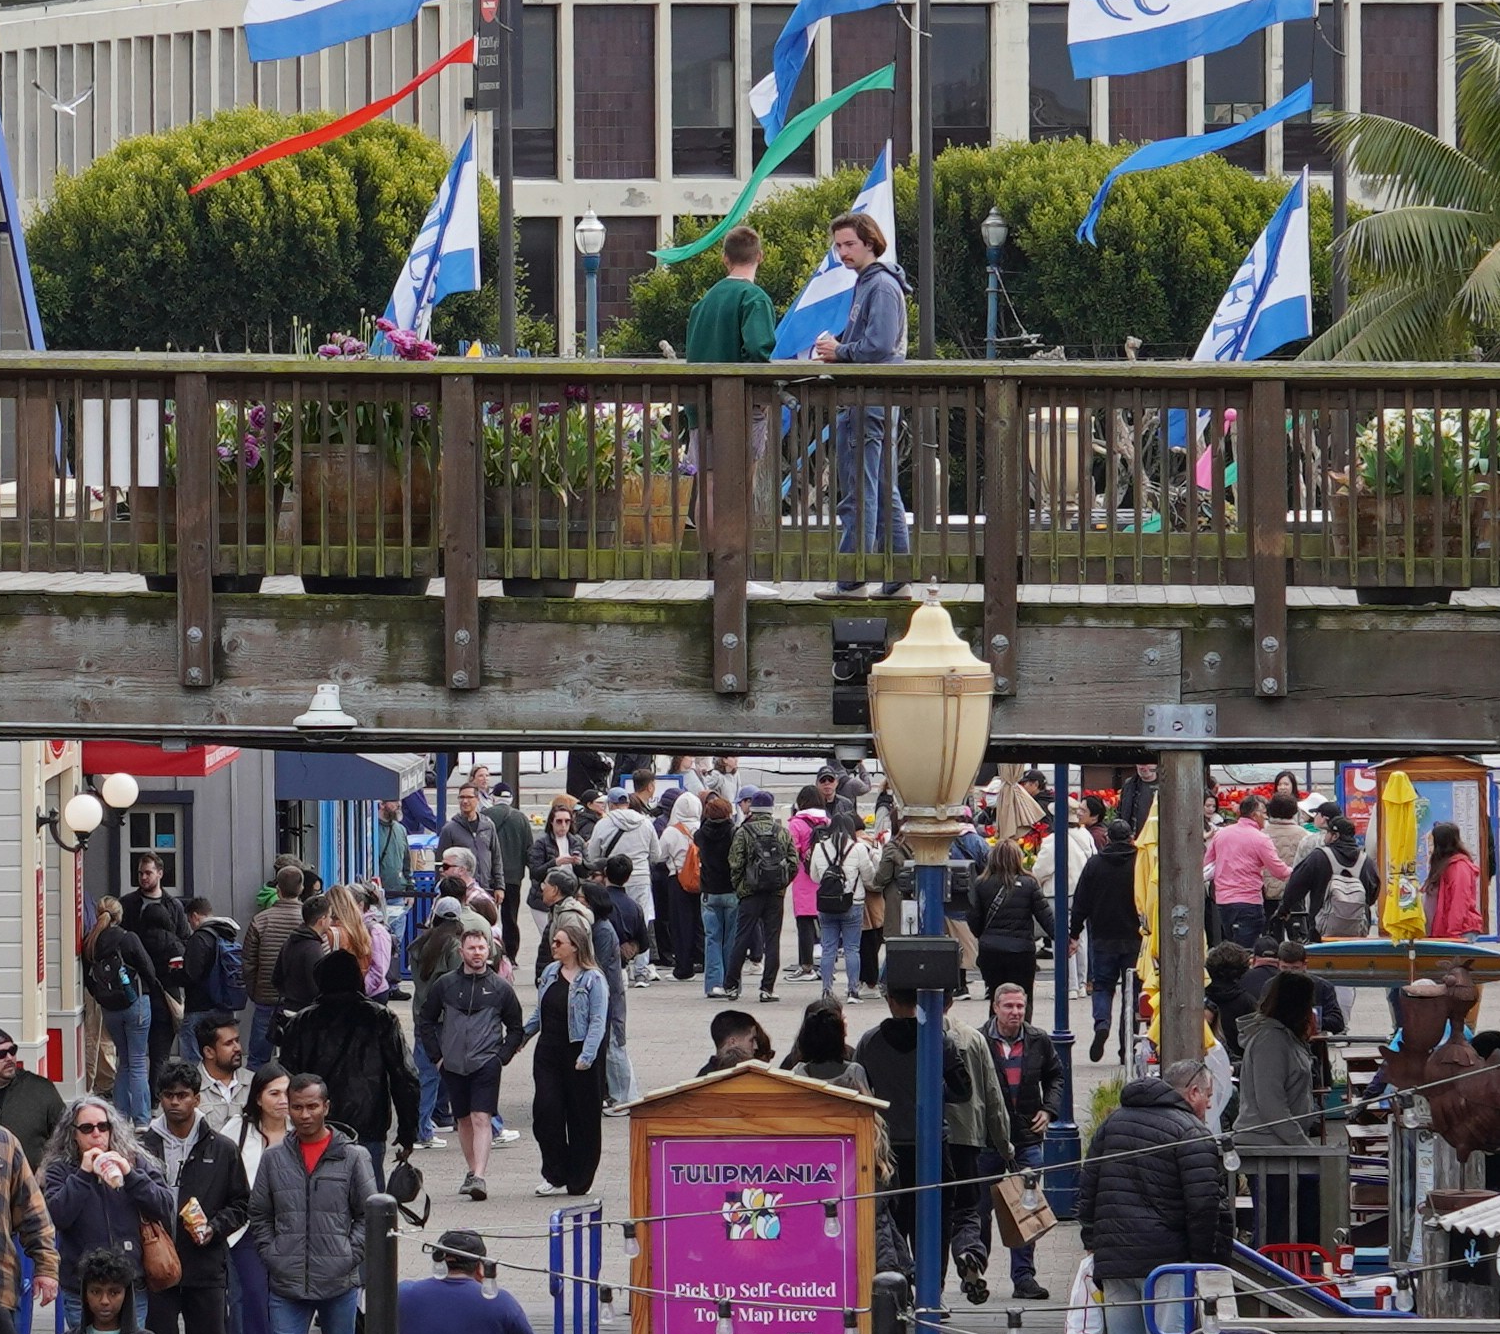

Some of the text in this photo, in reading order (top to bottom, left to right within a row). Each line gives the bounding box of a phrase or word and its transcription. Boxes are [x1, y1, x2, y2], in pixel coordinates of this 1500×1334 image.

[670, 1164, 836, 1186] TULIPMANIA
[674, 1281, 837, 1302] Pick Up Self-Guided
[694, 1307, 818, 1326] Tor Map Here
